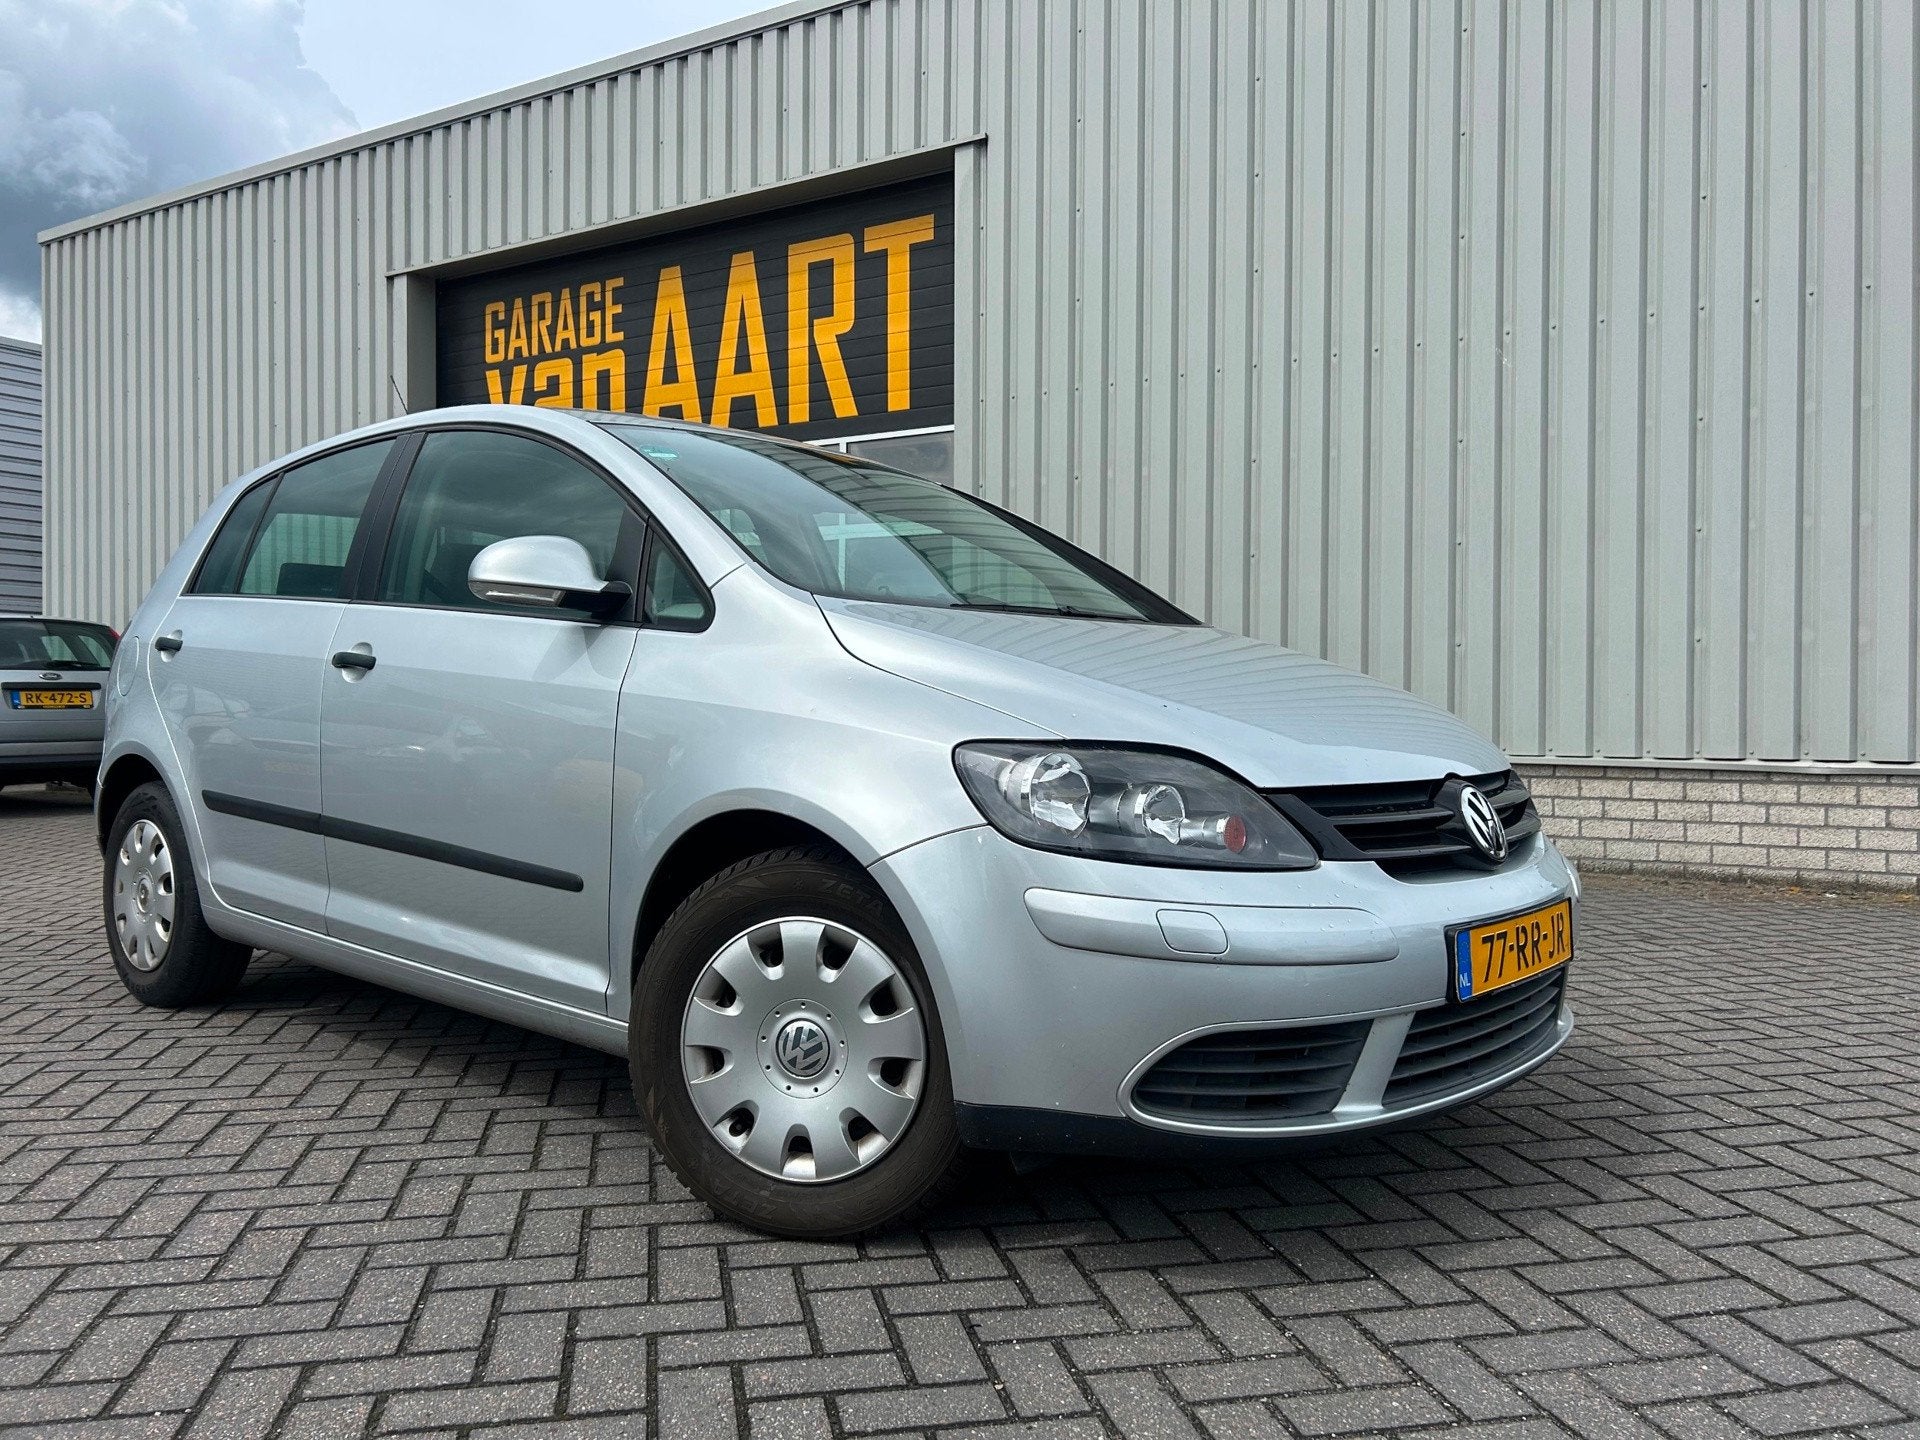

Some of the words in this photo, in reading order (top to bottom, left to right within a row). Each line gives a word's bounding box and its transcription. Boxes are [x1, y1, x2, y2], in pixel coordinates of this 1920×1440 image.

[485, 277, 625, 364] GARAGE
[643, 214, 935, 429] AART
[25, 692, 87, 704] RK-472-S
[1459, 973, 1472, 987] NL
[1481, 910, 1566, 984] 77-RR-JR
